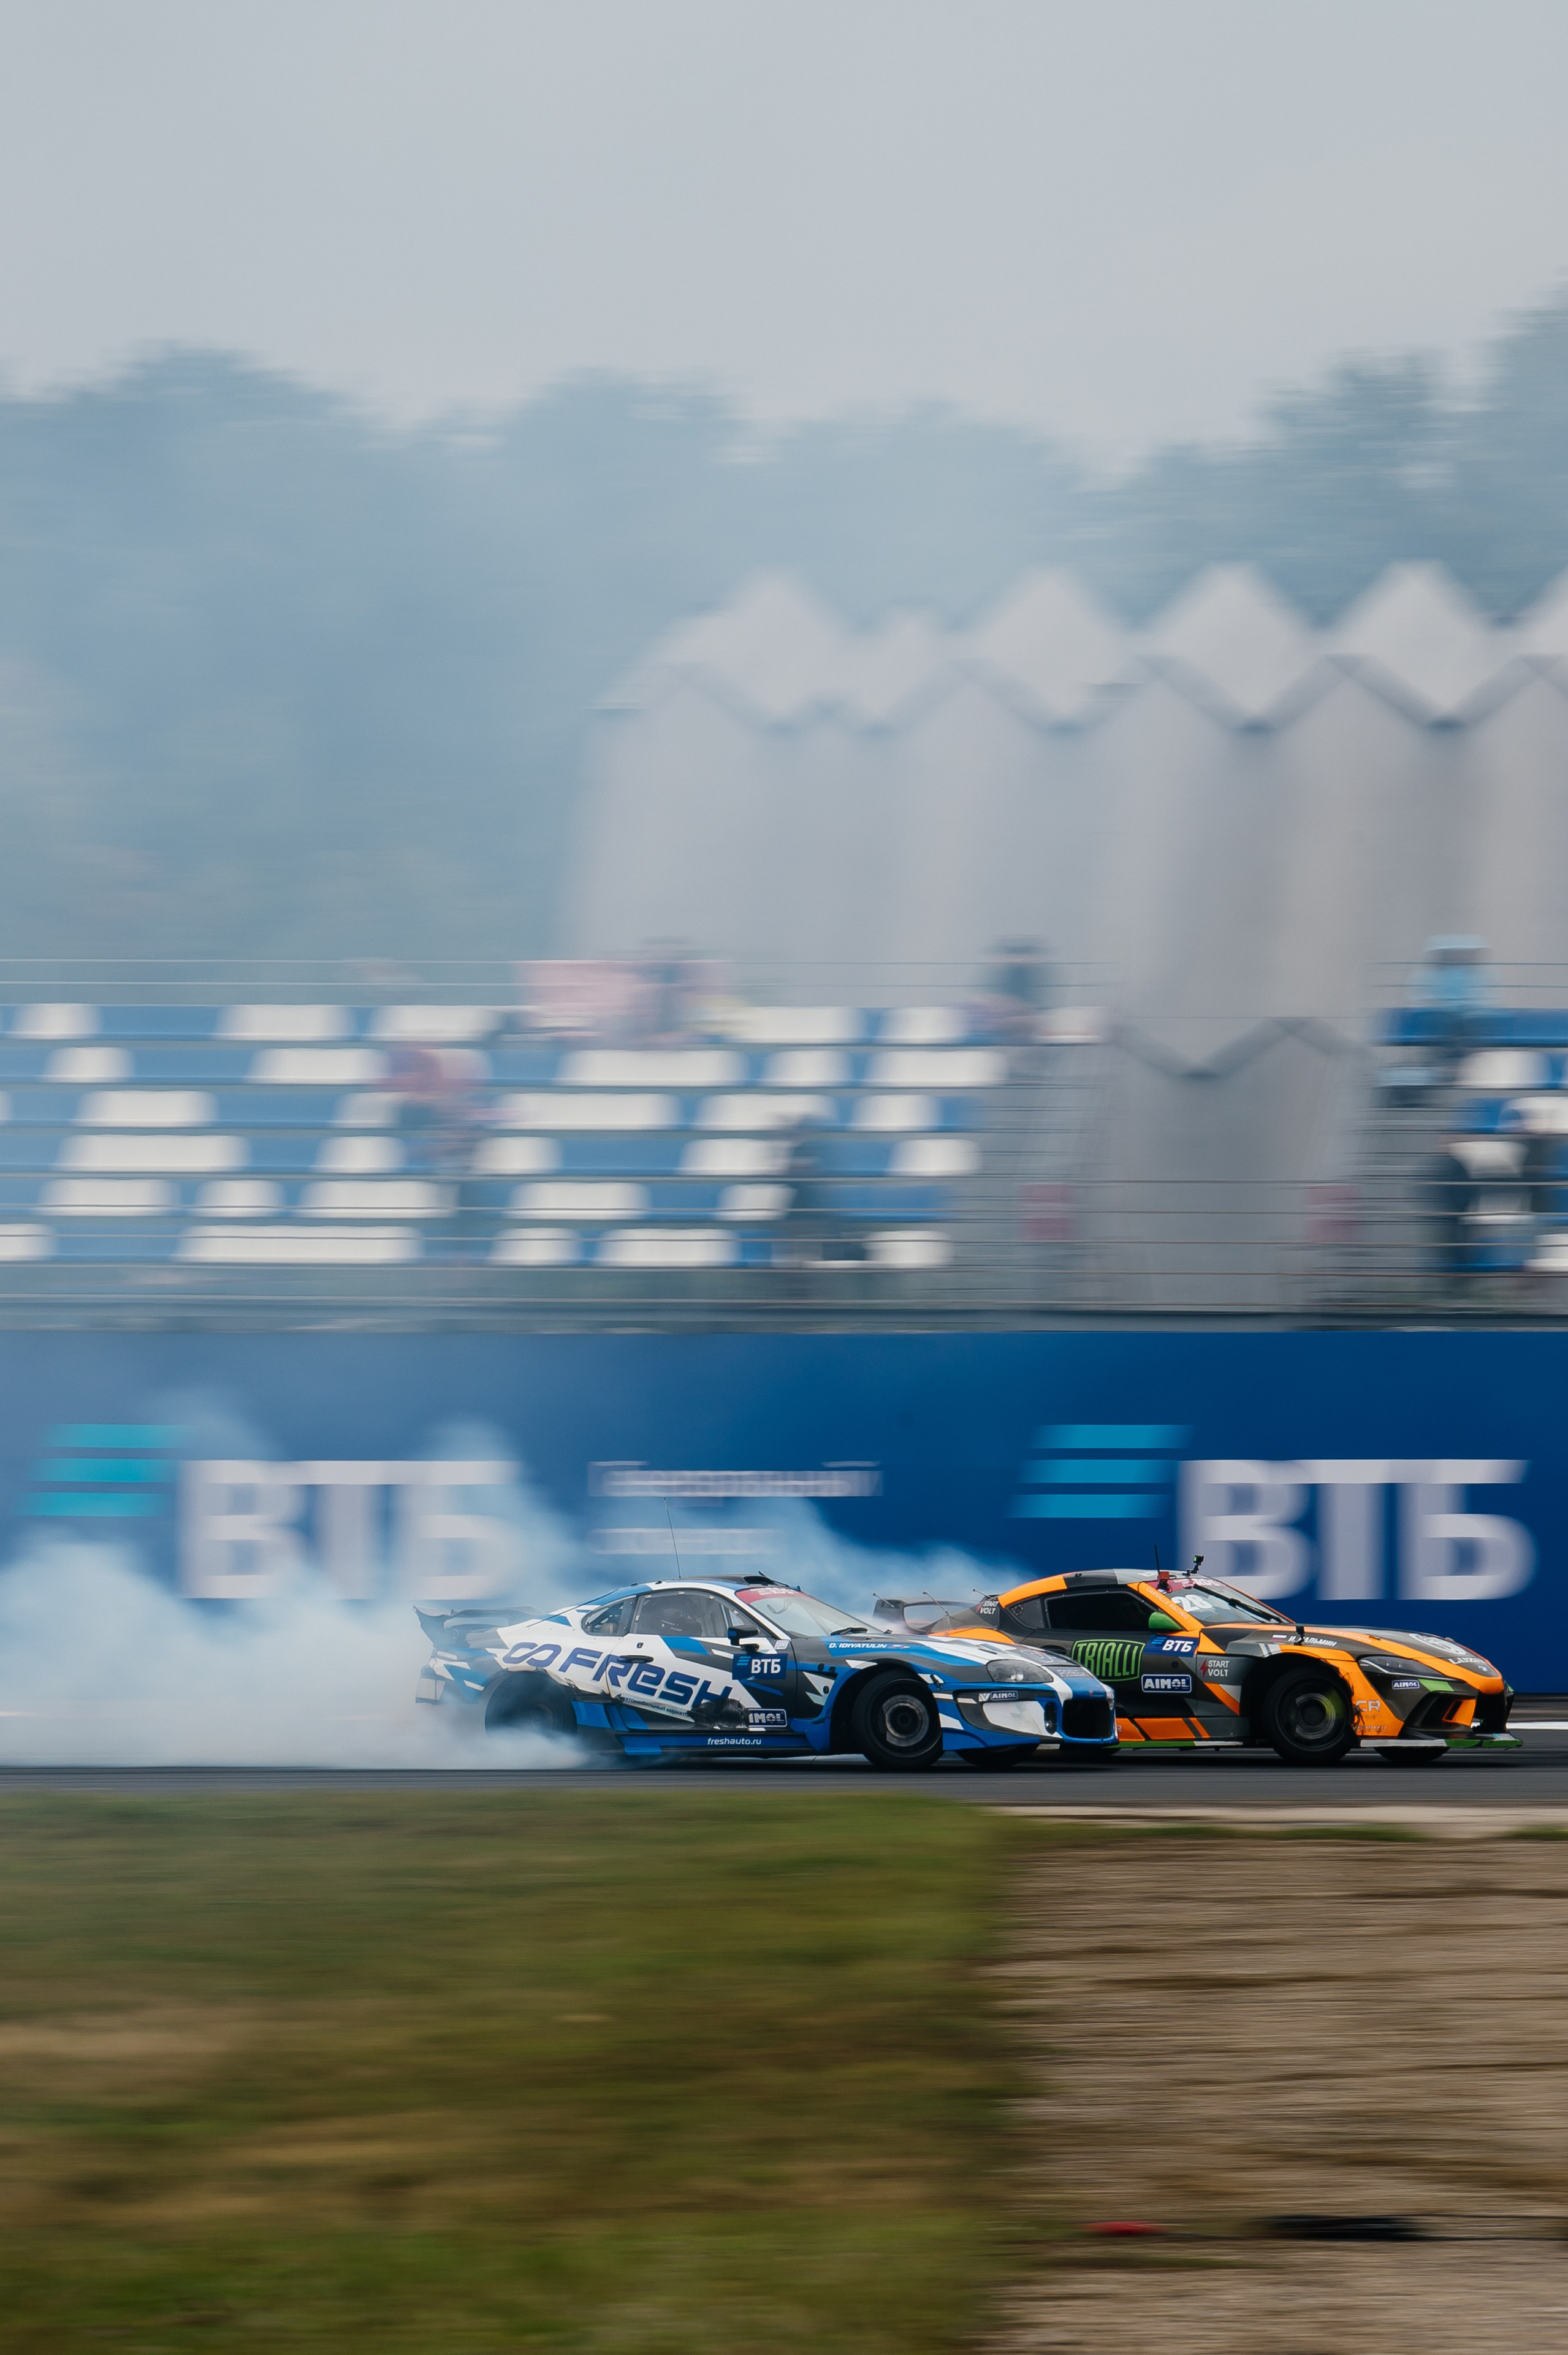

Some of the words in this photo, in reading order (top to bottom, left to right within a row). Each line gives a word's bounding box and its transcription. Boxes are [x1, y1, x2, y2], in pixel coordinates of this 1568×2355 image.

[1175, 1459, 1539, 1600] ВТБ
[1171, 1594, 1212, 1613] 28
[1168, 1602, 1189, 1620] RACING
[1162, 1639, 1194, 1652] ВТБ
[1076, 1642, 1139, 1677] TRIALLI
[1208, 1660, 1230, 1668] START
[751, 1658, 781, 1674] ВТБ
[1208, 1668, 1229, 1677] VOLT
[1144, 1678, 1190, 1689] AIMOL
[1355, 1700, 1381, 1712] CR
[748, 1712, 785, 1723] IMOL
[707, 1737, 762, 1746] freshauto.ru
